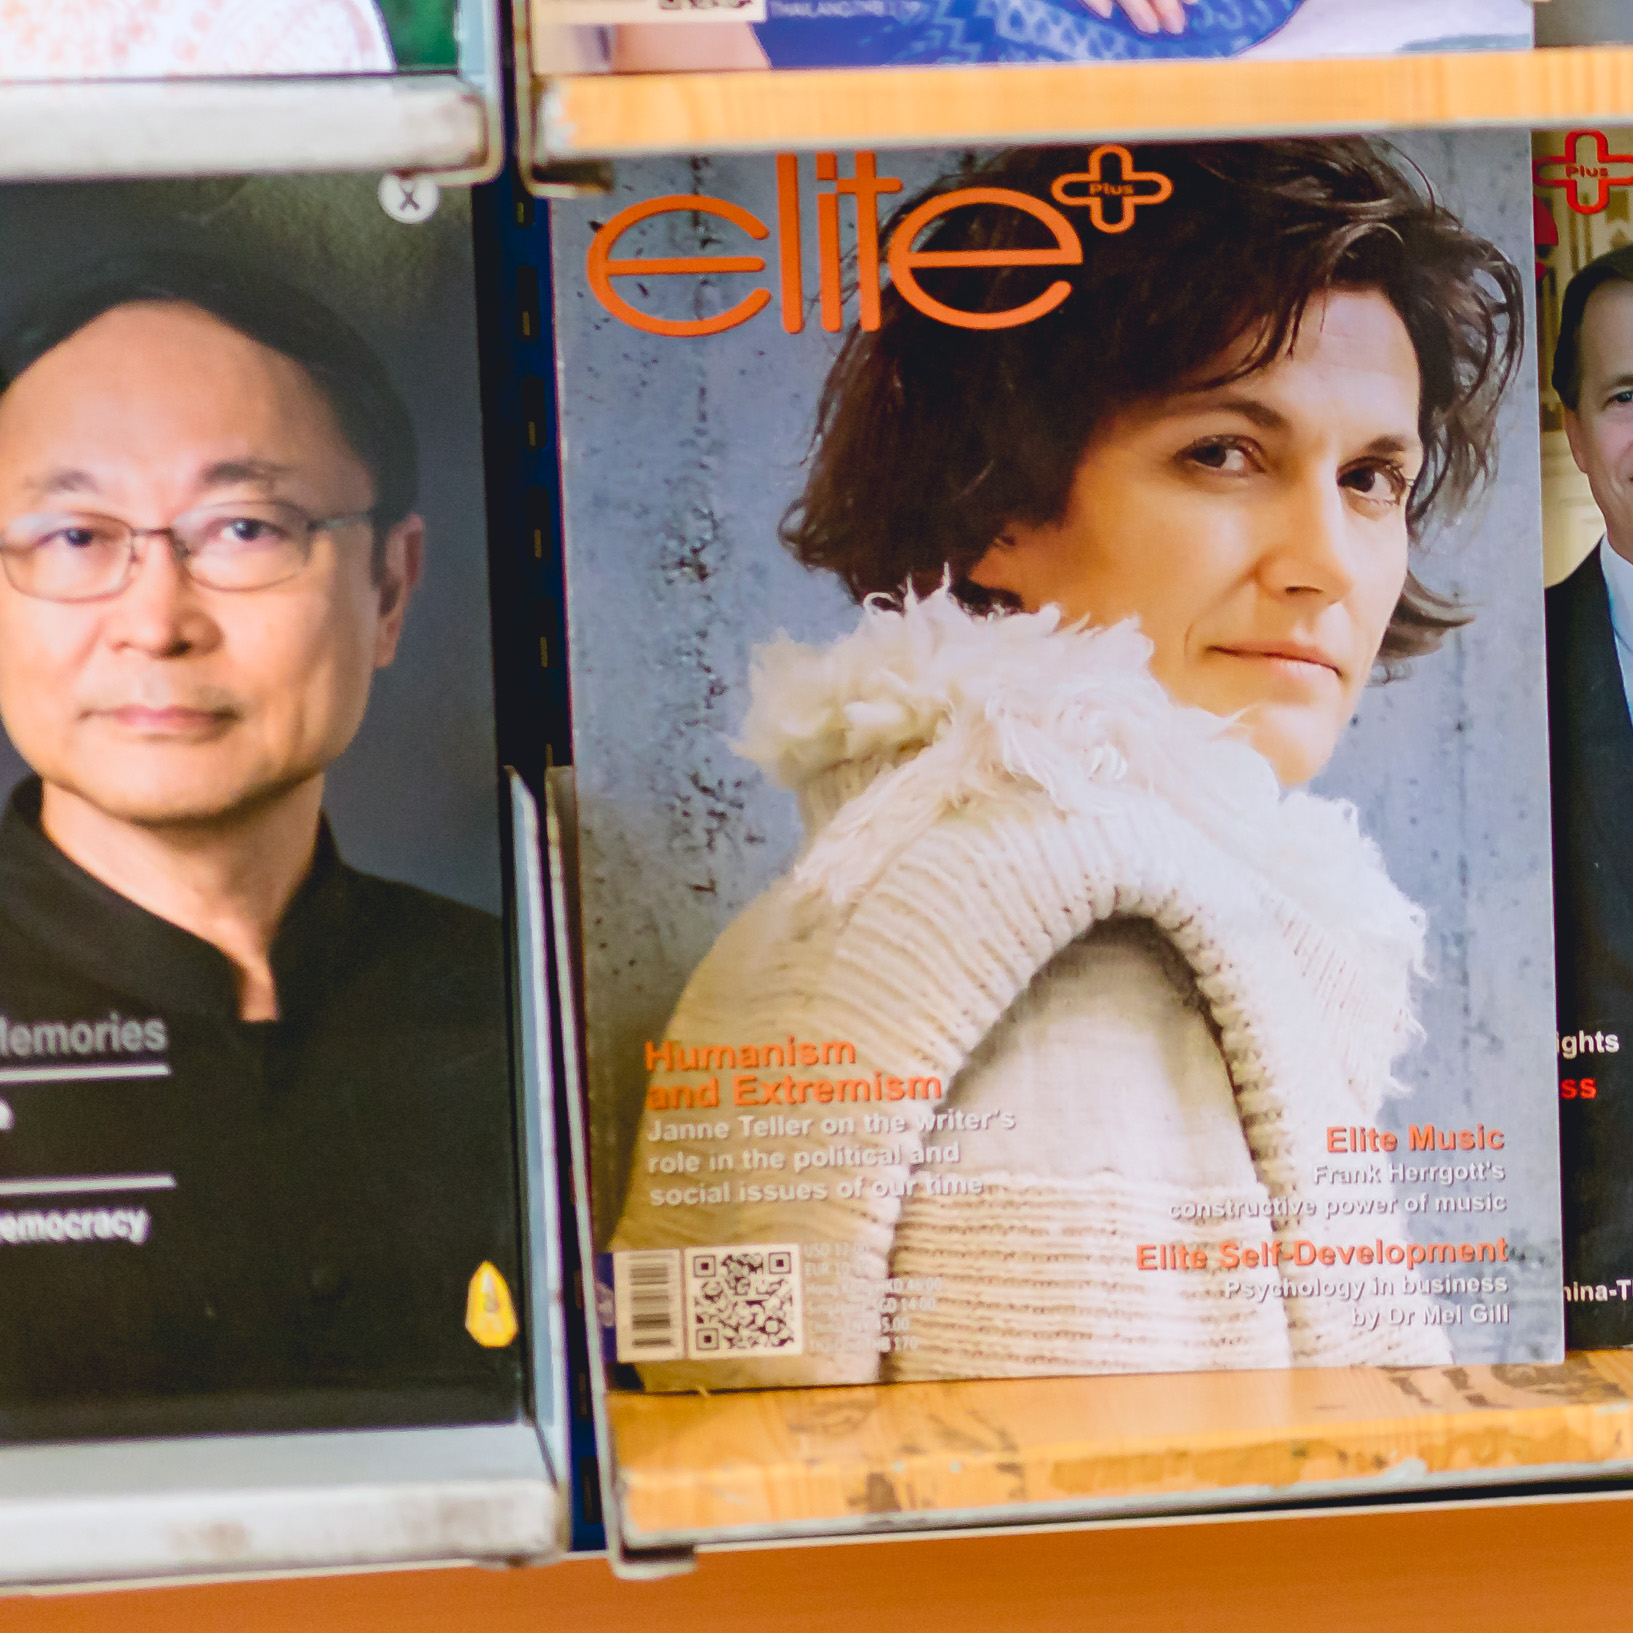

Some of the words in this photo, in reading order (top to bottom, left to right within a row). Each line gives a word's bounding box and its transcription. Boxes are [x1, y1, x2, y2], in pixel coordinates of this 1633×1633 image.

[1088, 183, 1134, 195] Plus
[586, 151, 1084, 338] elite
[645, 1035, 856, 1071] Humanism
[646, 1078, 719, 1110] and
[732, 1070, 942, 1107] Extremism
[648, 1119, 729, 1142] Janne
[737, 1115, 813, 1139] Teller
[820, 1117, 854, 1136] on
[863, 1112, 906, 1134] the
[916, 1108, 1016, 1132] writer's
[1326, 1126, 1398, 1154] Elite
[1408, 1123, 1505, 1152] Music
[649, 1152, 700, 1174] role
[709, 1152, 733, 1171] in
[742, 1149, 784, 1169] the
[794, 1146, 901, 1173] political
[911, 1142, 959, 1164] and
[1136, 1243, 1208, 1271] Elite
[1218, 1238, 1509, 1270] Self-Development
